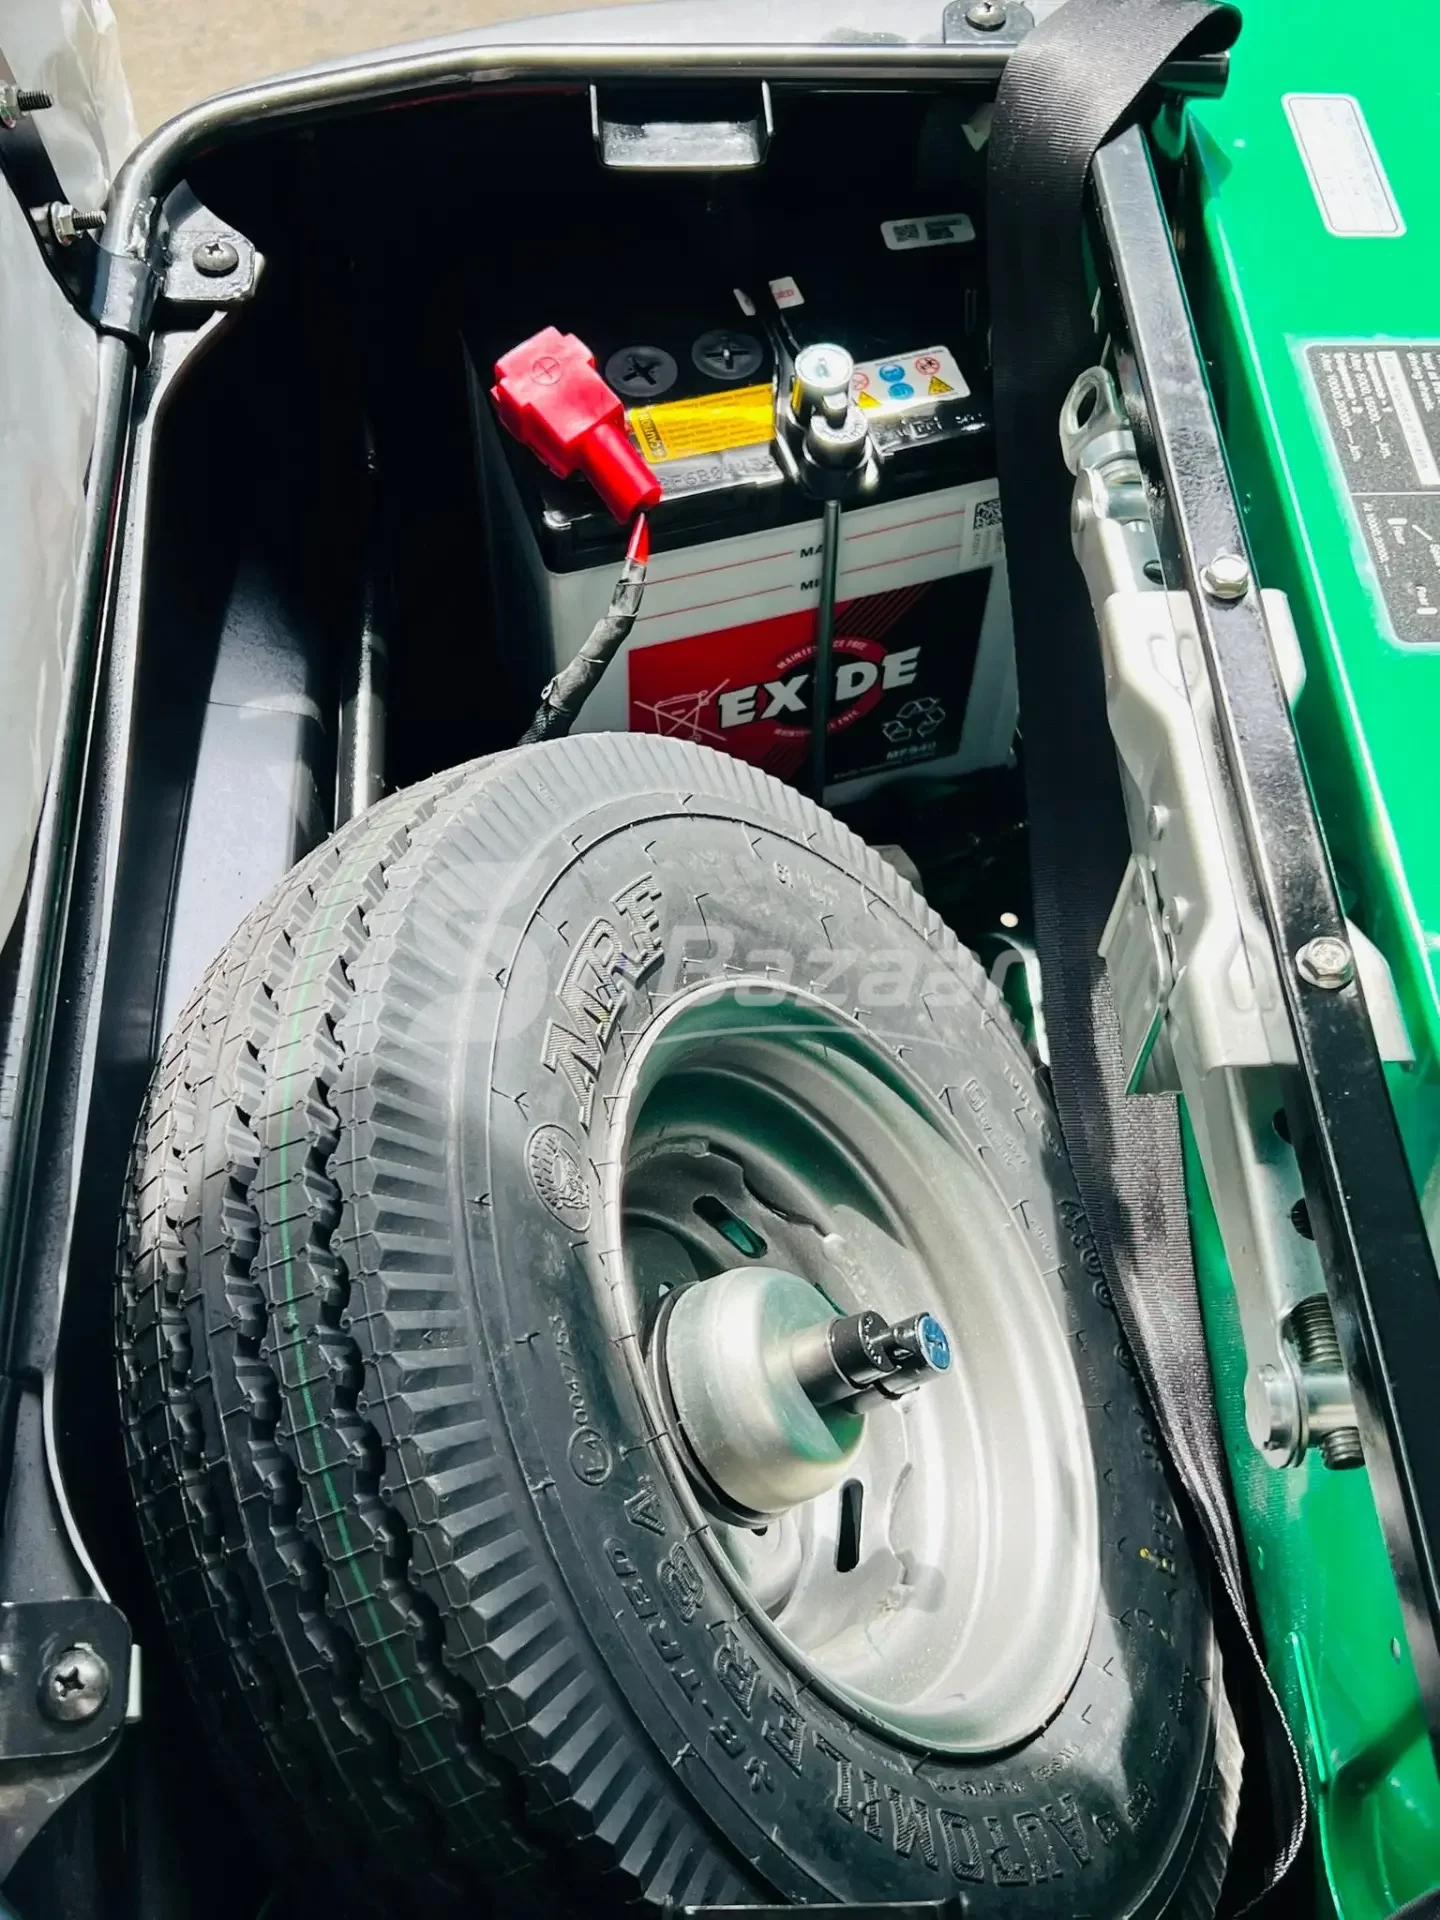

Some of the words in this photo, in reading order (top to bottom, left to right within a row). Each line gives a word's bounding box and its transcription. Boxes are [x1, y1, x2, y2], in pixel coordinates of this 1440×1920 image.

[800, 544, 824, 559] MA
[800, 577, 820, 592] MI
[718, 646, 922, 729] EXDE
[540, 872, 665, 1130] MRF
[713, 1624, 1095, 1887] AUTOMILER
